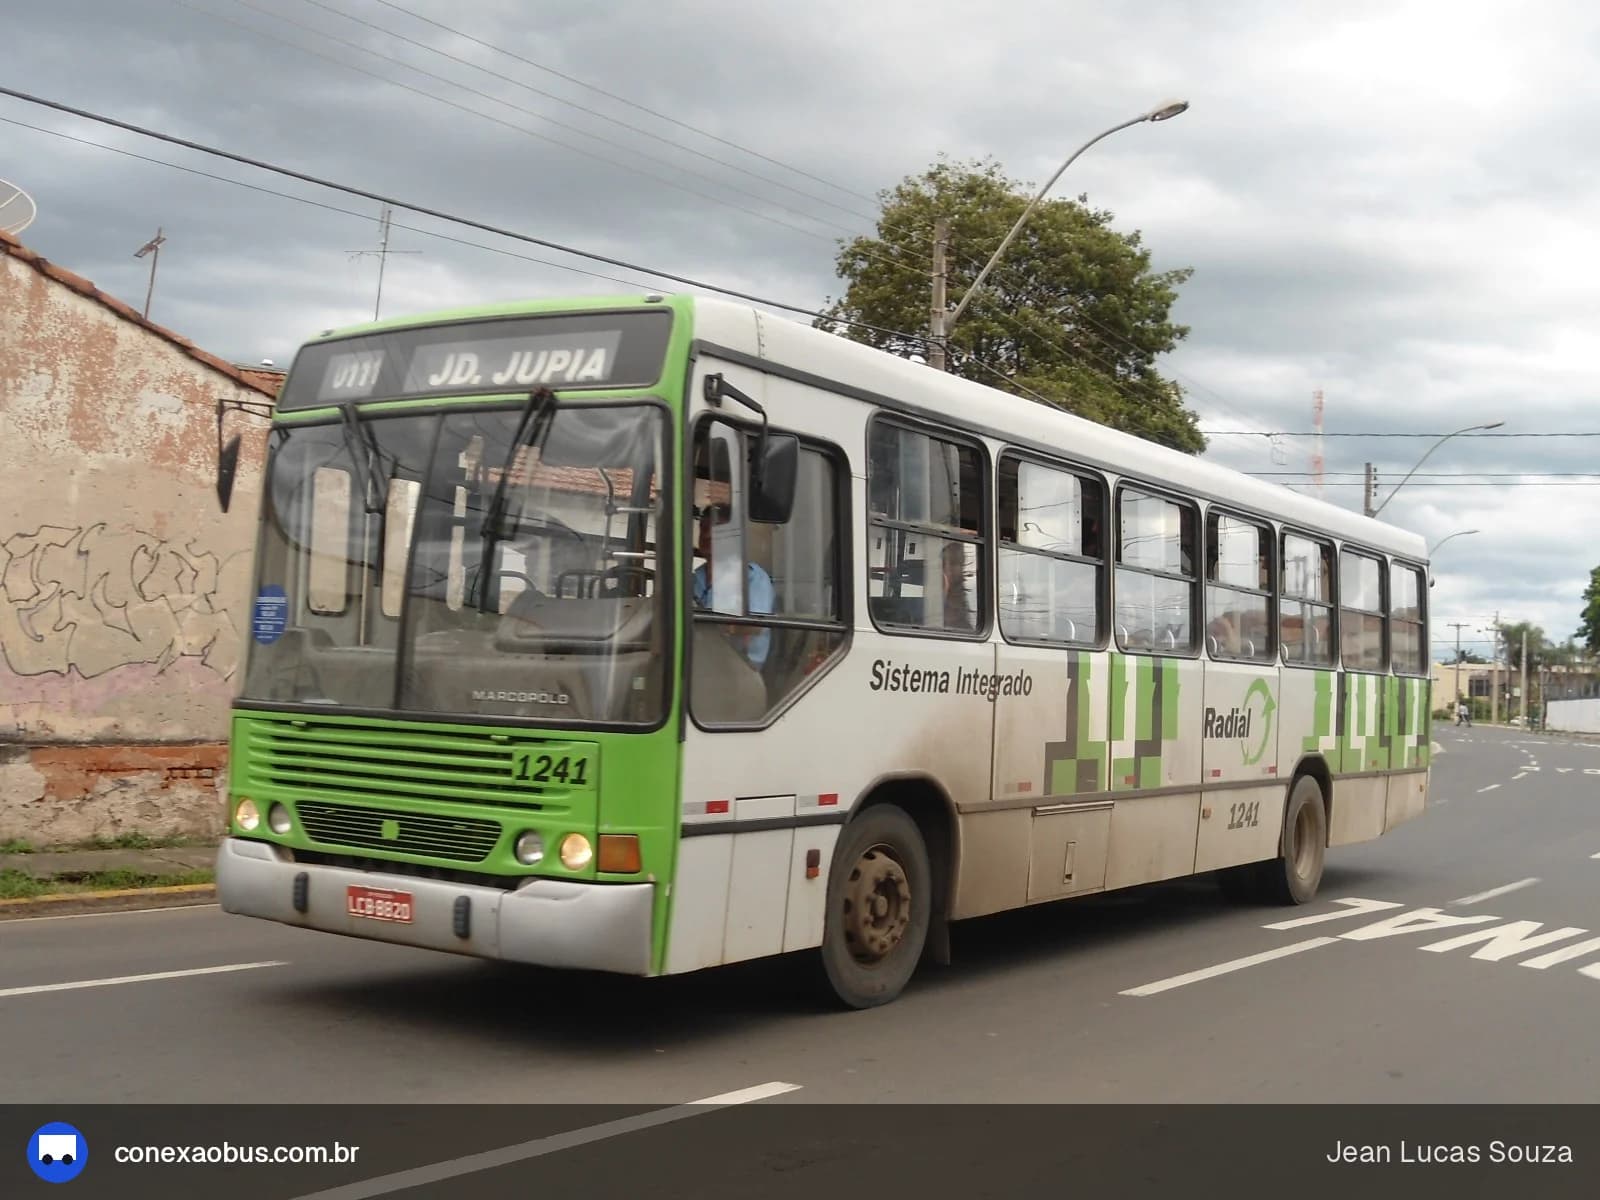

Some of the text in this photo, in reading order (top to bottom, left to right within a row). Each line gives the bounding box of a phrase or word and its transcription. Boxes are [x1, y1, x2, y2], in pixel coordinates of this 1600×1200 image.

[428, 348, 607, 386] JD. JUPIA
[869, 659, 1032, 702] Sistema Integrado
[471, 690, 569, 704] MARCOPOLO
[1204, 707, 1251, 738] Radial
[515, 754, 587, 785] 1241
[1227, 801, 1260, 830] 1241
[1261, 897, 1600, 980] INAL
